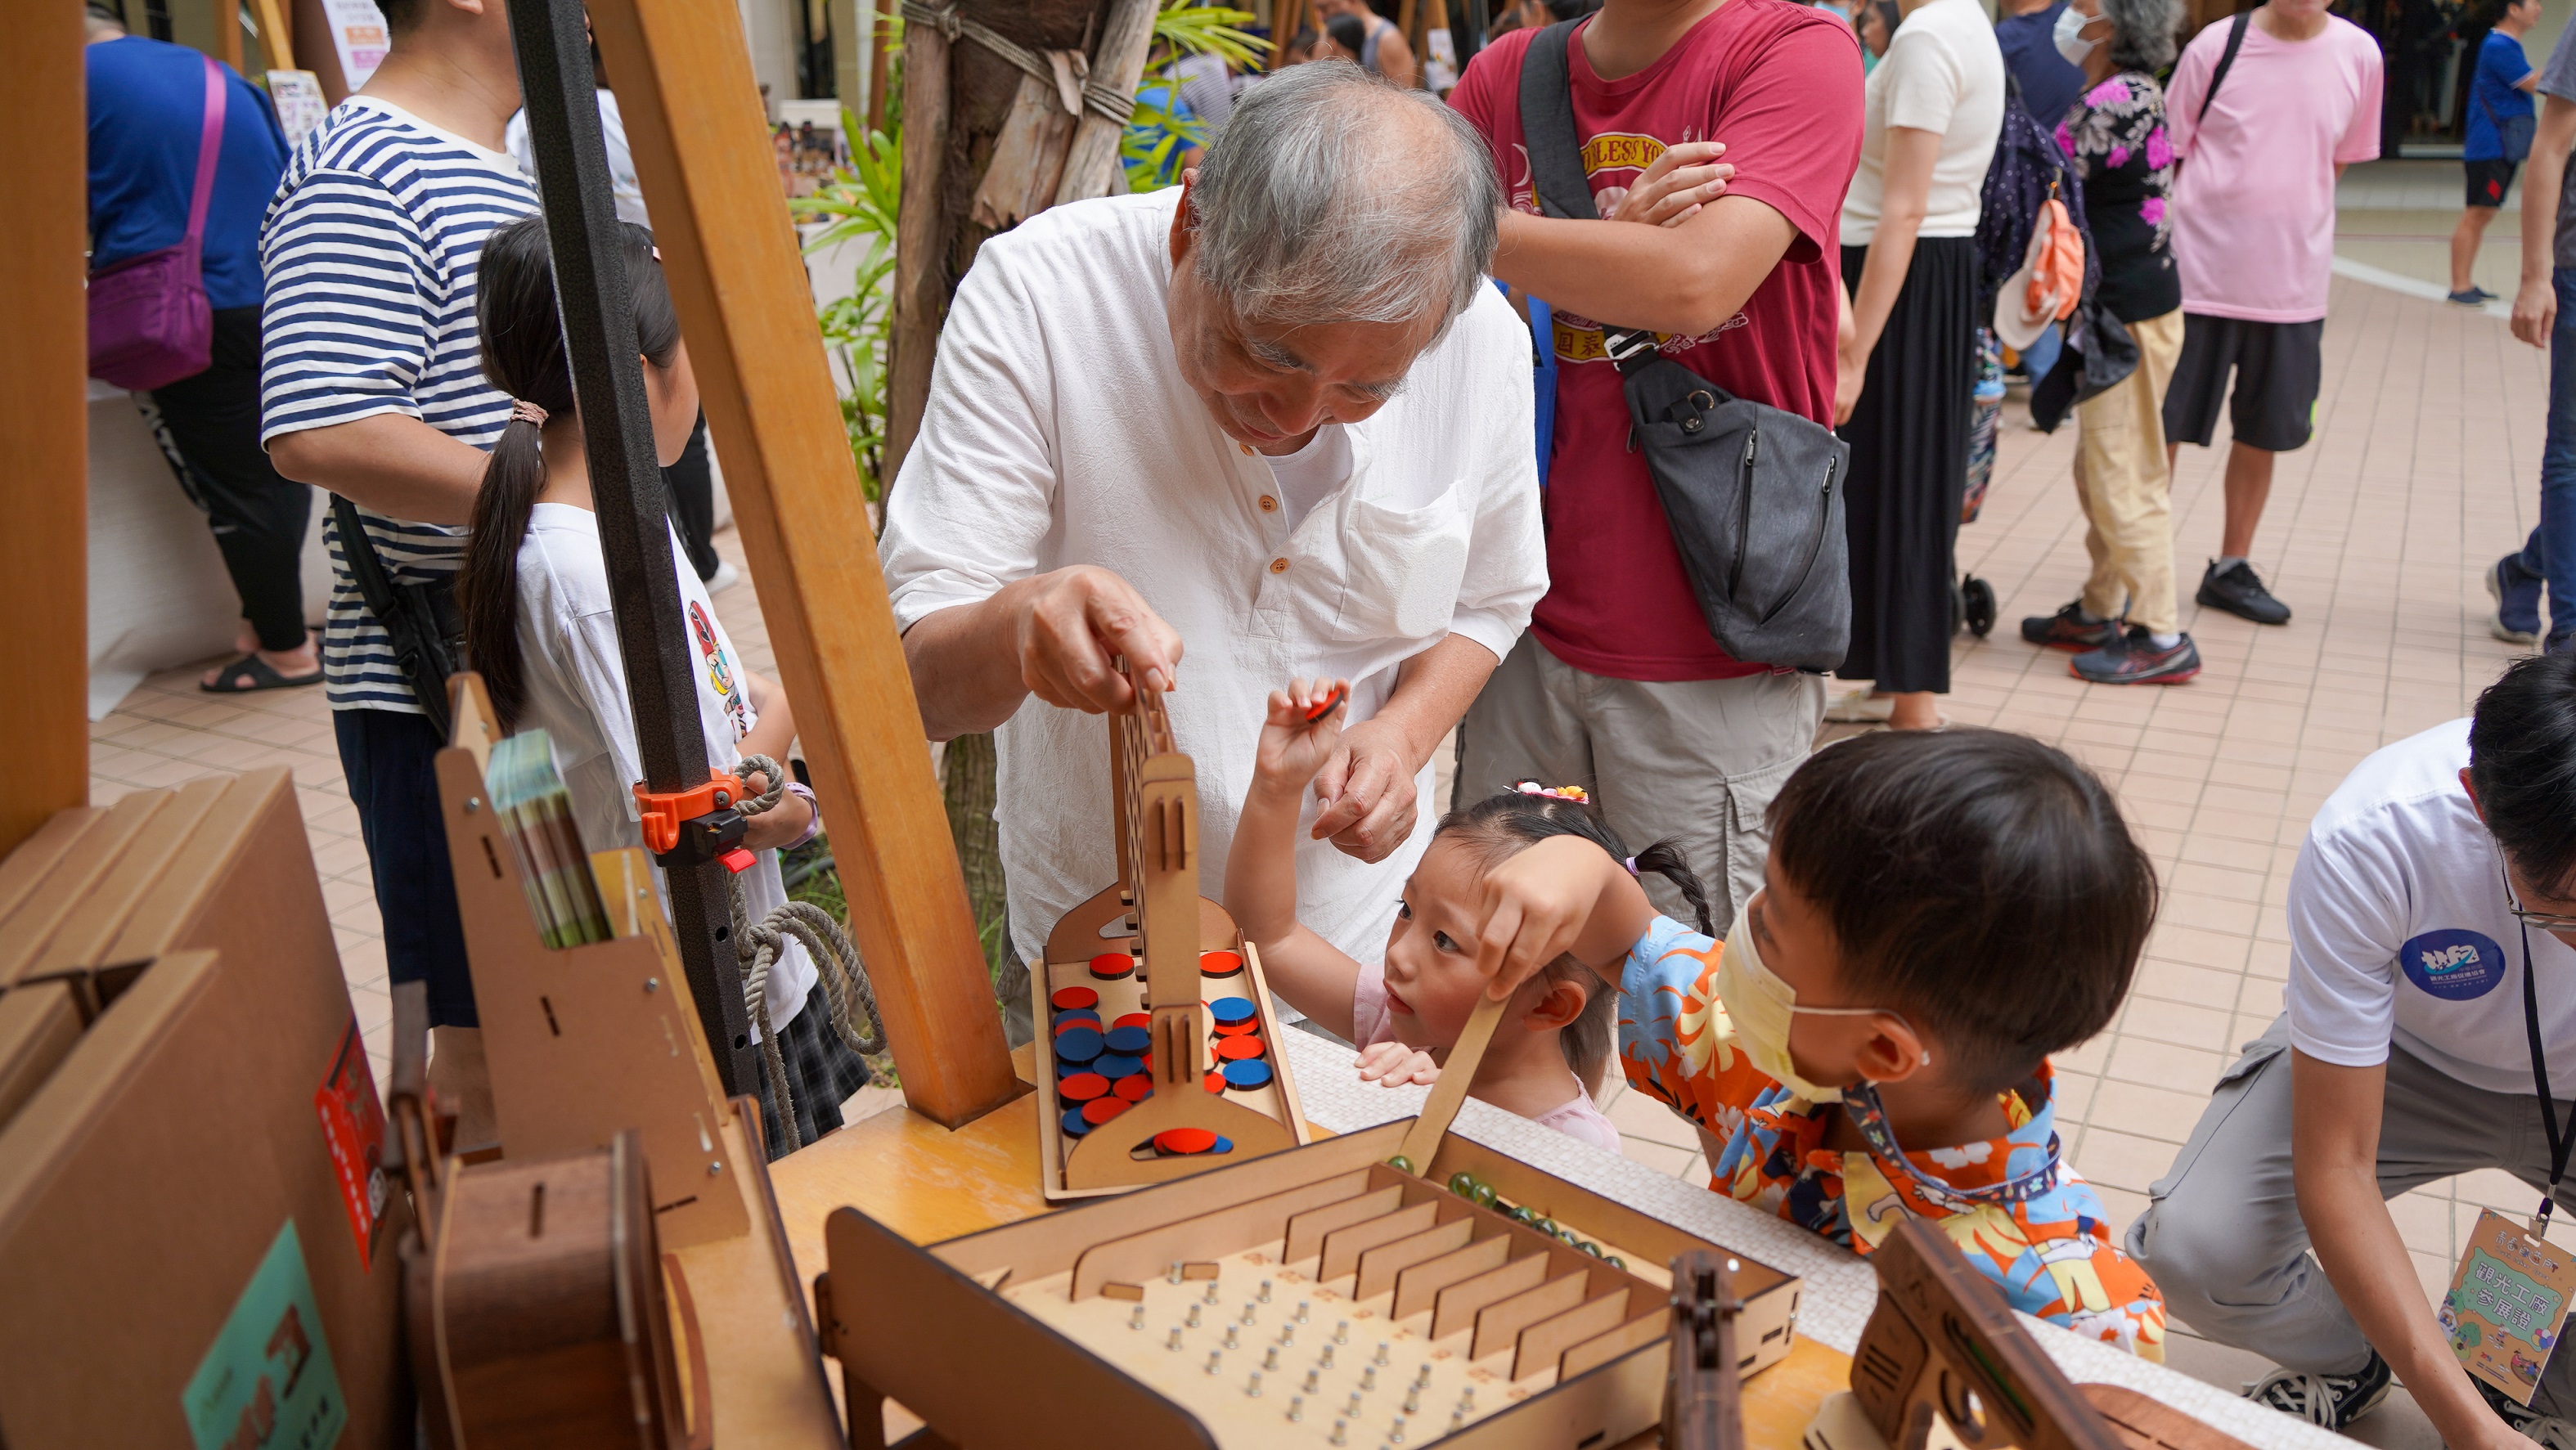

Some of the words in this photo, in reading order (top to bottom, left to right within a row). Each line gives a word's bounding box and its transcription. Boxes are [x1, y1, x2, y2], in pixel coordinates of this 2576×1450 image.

[1642, 141, 1666, 163] YO
[2475, 1262, 2549, 1316] 觀光工廠
[2477, 1287, 2531, 1331] 參展證
